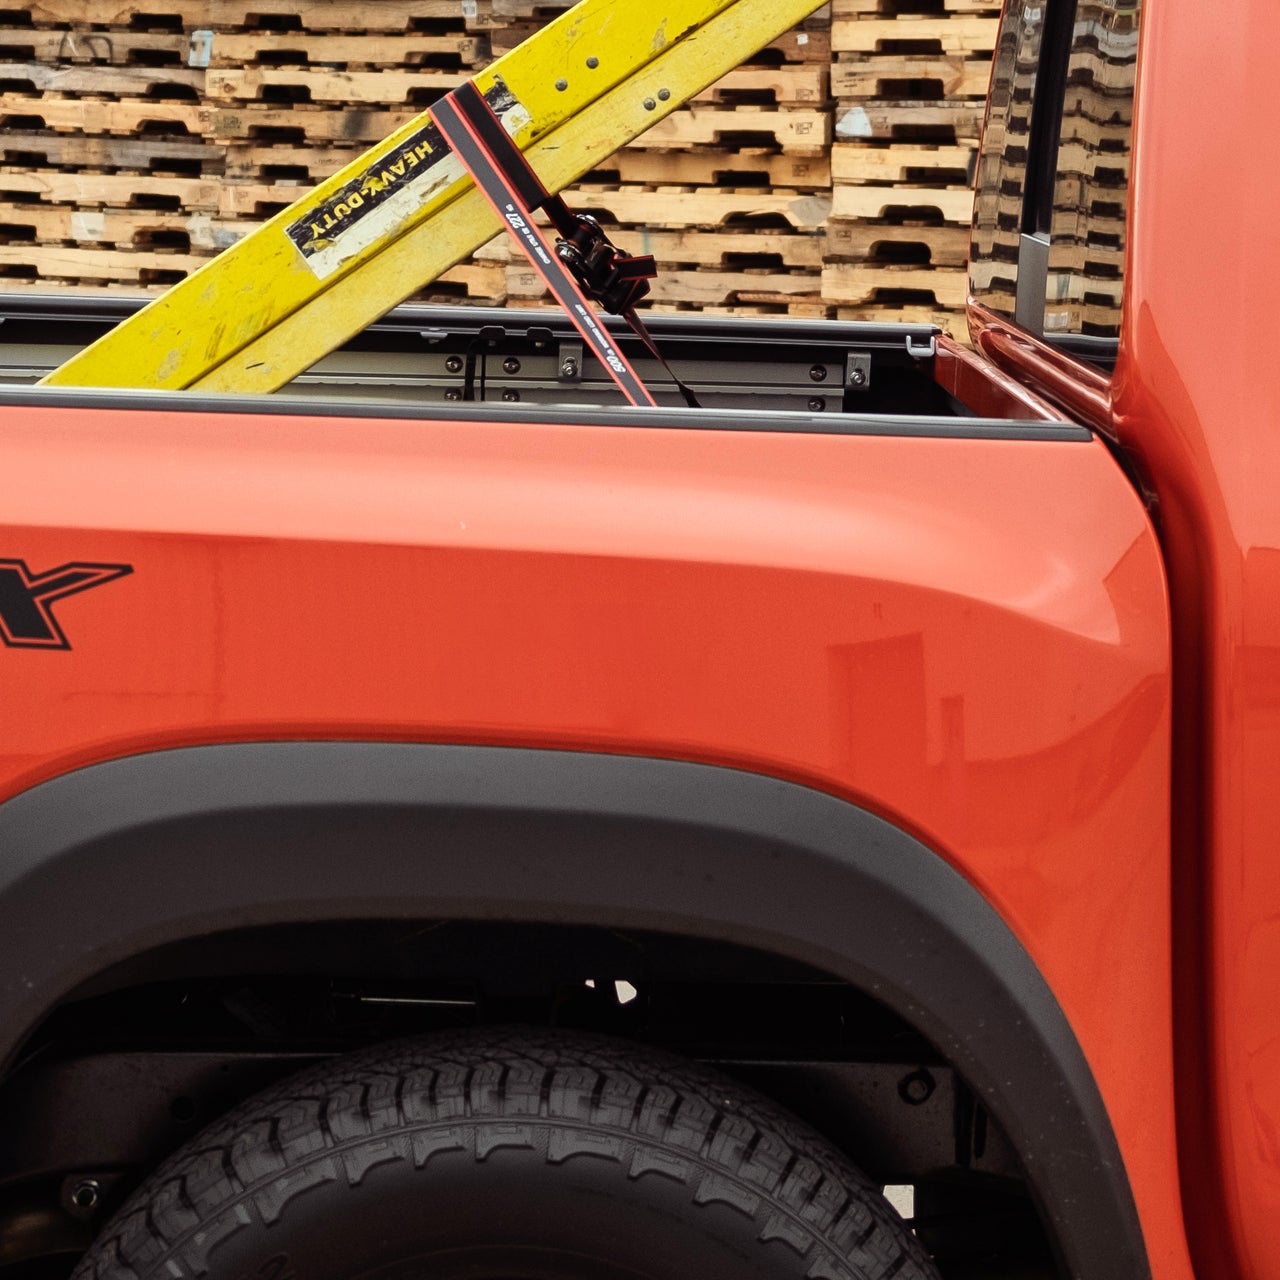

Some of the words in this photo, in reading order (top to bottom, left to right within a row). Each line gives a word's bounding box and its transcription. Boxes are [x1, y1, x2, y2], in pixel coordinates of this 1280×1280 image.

[309, 139, 434, 239] HEAVY-DUTY
[505, 212, 526, 229] 227
[606, 352, 627, 373] 500
